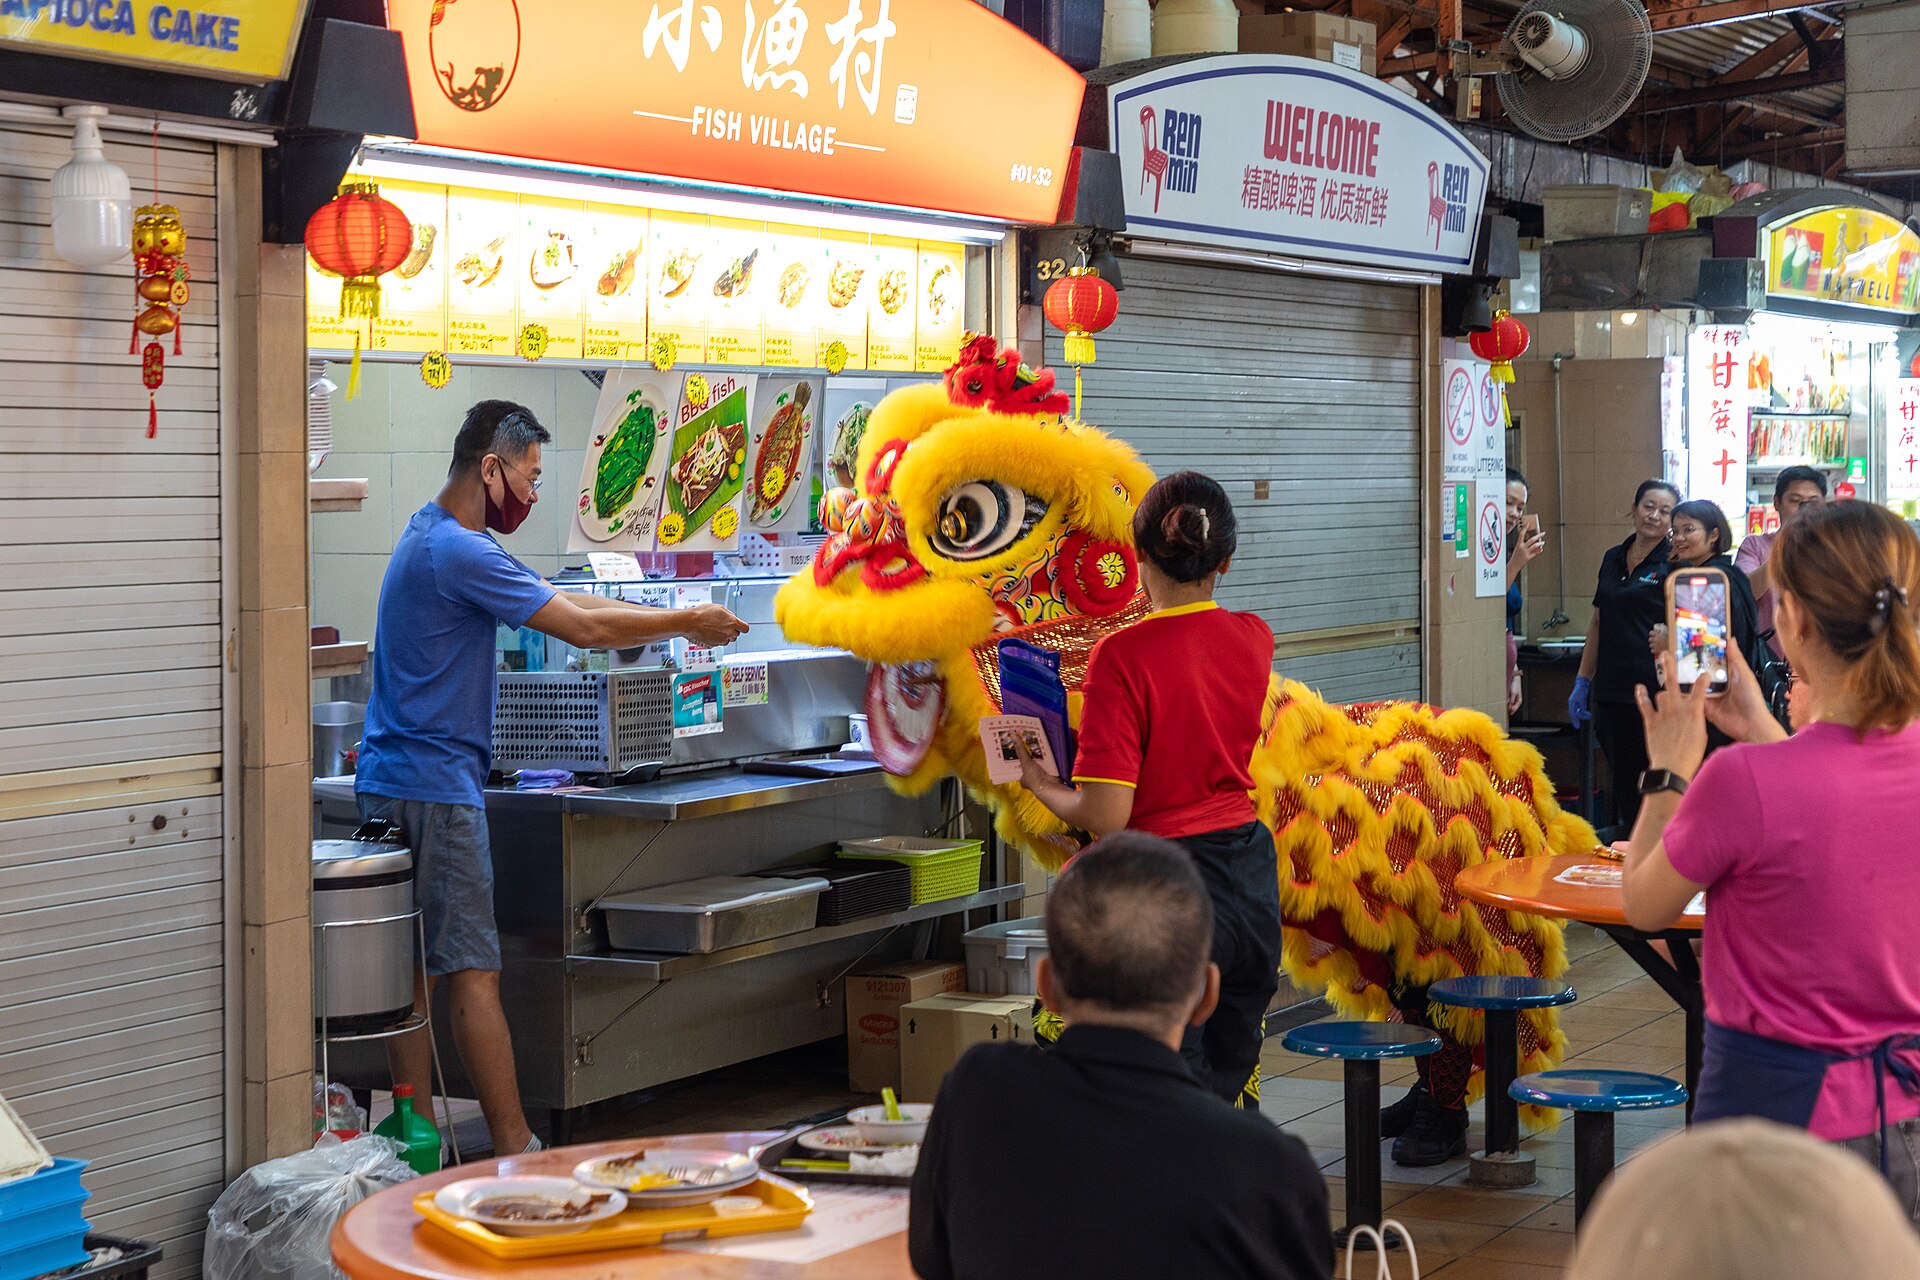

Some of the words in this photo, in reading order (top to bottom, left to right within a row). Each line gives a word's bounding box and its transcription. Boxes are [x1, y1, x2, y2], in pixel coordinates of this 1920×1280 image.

[148, 5, 240, 51] CAKE
[692, 105, 742, 141] FISH
[750, 115, 836, 155] VILLAGE
[1263, 100, 1380, 178] WELCOME
[1010, 163, 1052, 187] #01-32
[1241, 164, 1318, 218] 精酿啤酒
[1320, 179, 1389, 228] 优质新鲜
[1037, 258, 1067, 281] 32
[712, 376, 736, 404] fish
[663, 523, 680, 533] NEW
[1484, 569, 1489, 580] By
[1490, 569, 1498, 578] Law
[732, 667, 744, 683] SELF
[745, 665, 765, 682] SERVICE
[866, 981, 906, 992] 9121307
